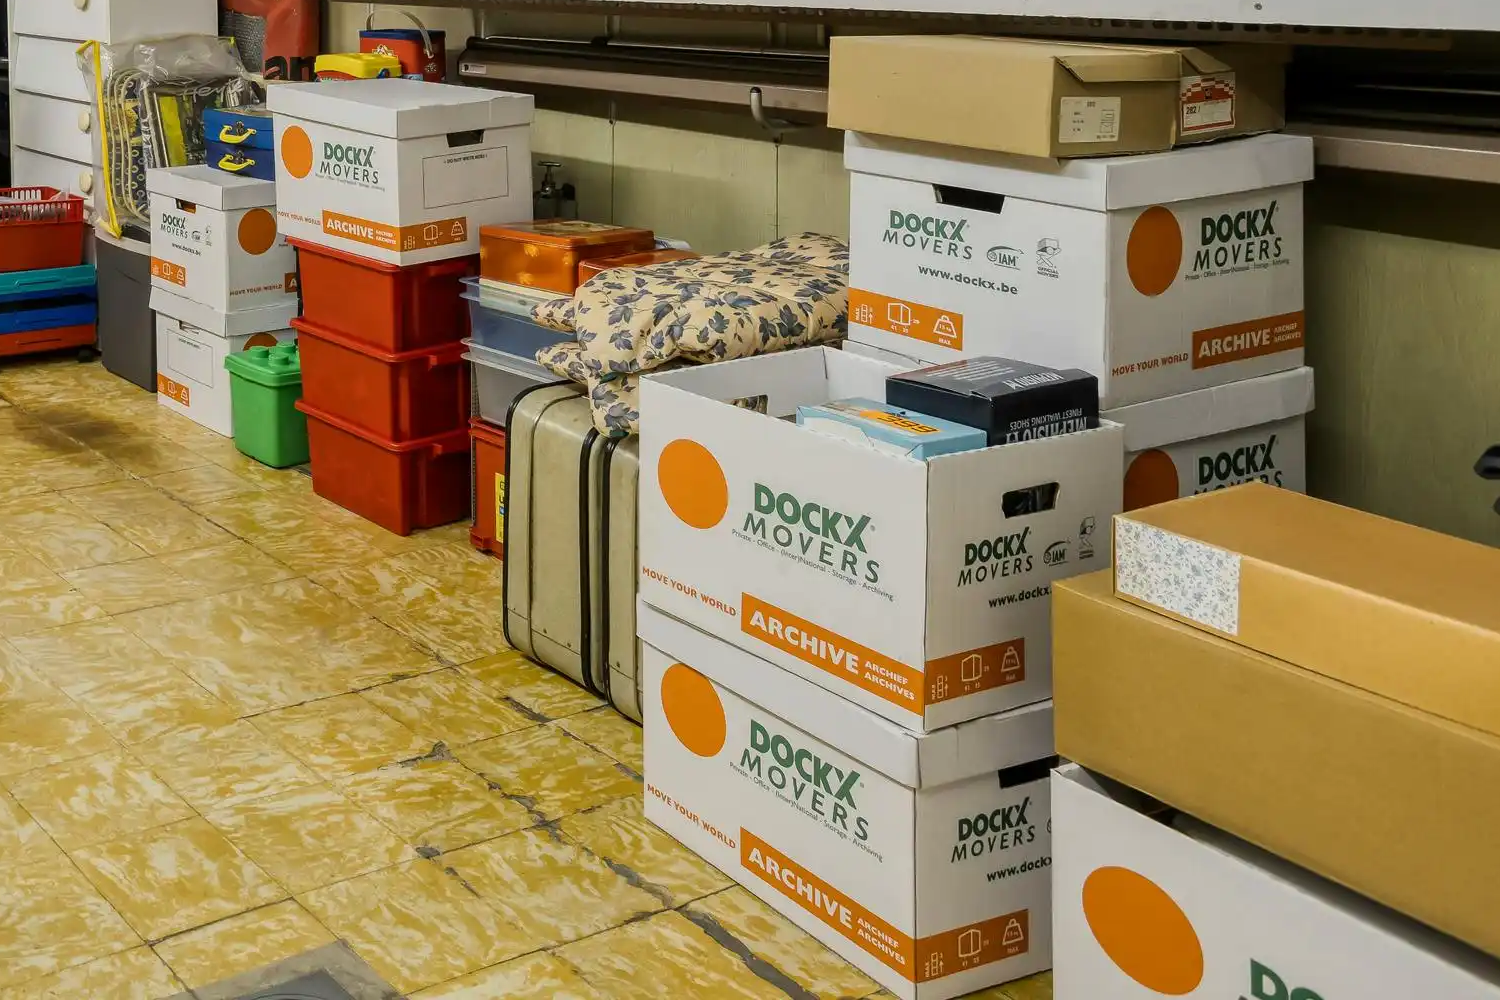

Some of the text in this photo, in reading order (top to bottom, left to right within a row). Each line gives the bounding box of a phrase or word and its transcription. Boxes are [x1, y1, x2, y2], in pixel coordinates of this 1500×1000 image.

[323, 142, 374, 169] DOCKX
[320, 161, 379, 185] MOVERS
[161, 224, 188, 239] MOVERS
[162, 212, 186, 230] DOCKX
[326, 218, 374, 240] ARCHIVE
[889, 210, 967, 242] DOCKX
[1201, 200, 1277, 246] DOCKX
[882, 229, 973, 260] MOVERS
[1193, 237, 1282, 271] MOVERS
[918, 265, 1018, 295] www.dockx.be
[1198, 328, 1271, 358] ARCHIVE
[1112, 353, 1189, 376] MOVE YOUR WORLD
[1010, 408, 1083, 431] FINEST WALKING SHOES
[1198, 434, 1277, 485] DOCKX
[754, 482, 872, 554] DOCKX
[743, 512, 880, 584] MOVERS
[965, 526, 1030, 566] DOCKX
[756, 539, 775, 552] Office
[832, 569, 857, 585] Storage
[862, 582, 894, 602] Archiving
[957, 555, 1033, 587] MOVERS
[642, 565, 737, 617] MOVE YOUR WORLD
[749, 610, 859, 675] ARCHIVE
[864, 660, 909, 685] ARCHIEF
[864, 671, 916, 701] ARCHIVES
[750, 718, 861, 810] DOCKX
[740, 748, 869, 842] MOVERS
[647, 783, 737, 850] MOVE YOUR WORLD
[823, 819, 847, 841] Storage
[958, 796, 1030, 842] DOCKX
[951, 825, 1035, 863] MOVERS
[748, 847, 853, 930] ARCHIVE
[857, 917, 899, 948] ARCHIEF
[857, 930, 906, 966] ARCHIVES
